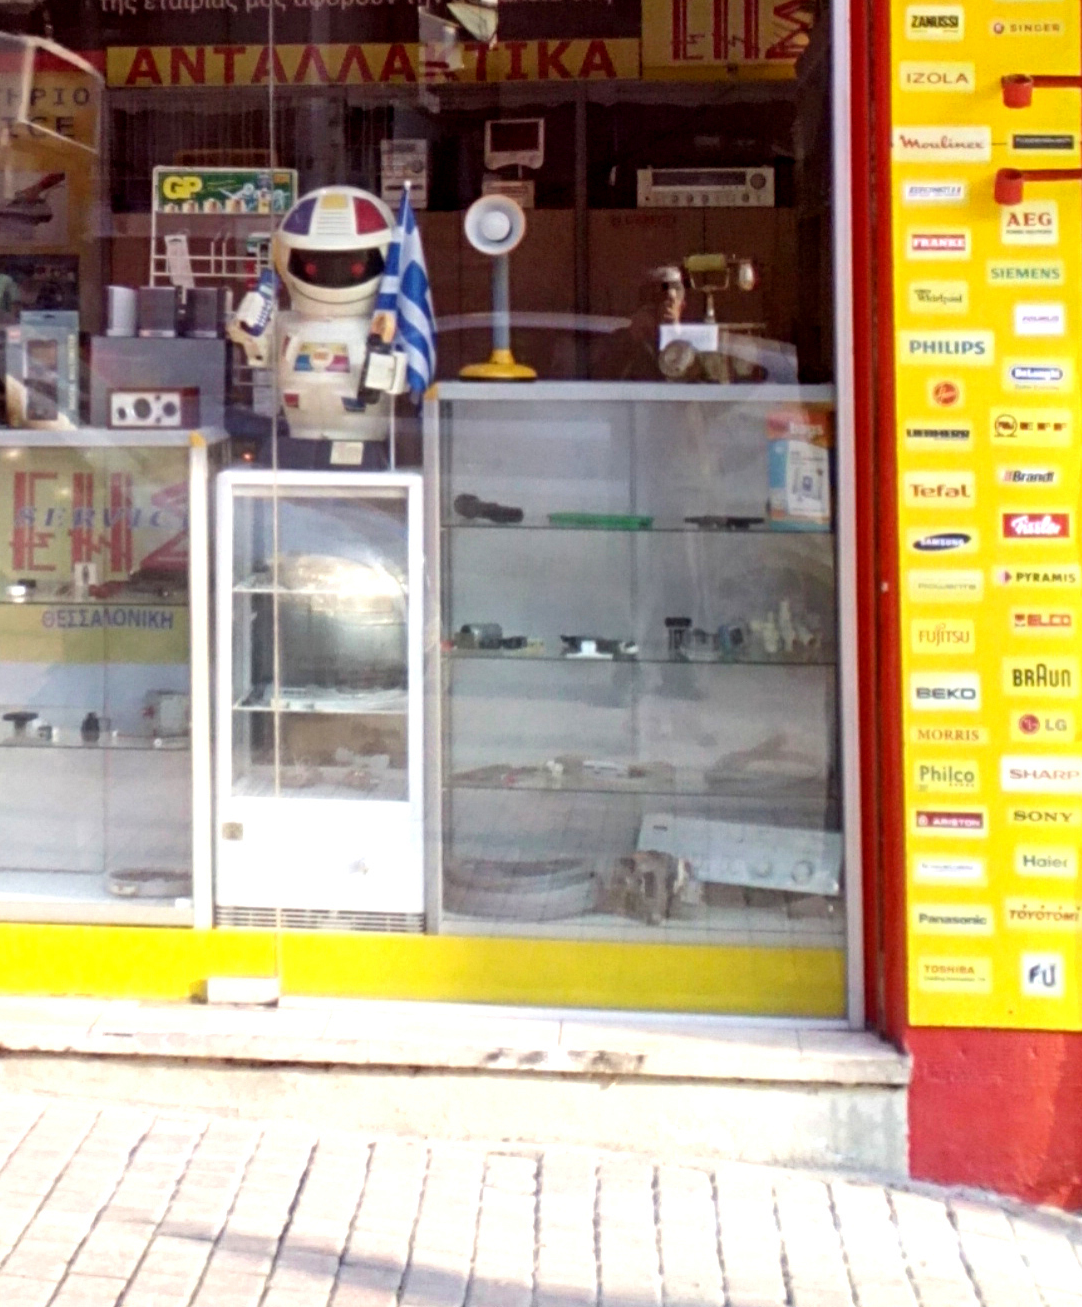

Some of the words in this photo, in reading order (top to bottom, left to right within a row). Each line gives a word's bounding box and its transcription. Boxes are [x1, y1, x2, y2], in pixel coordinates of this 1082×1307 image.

[911, 15, 959, 28] ZANUSSI
[1010, 23, 1059, 32] SINGER
[906, 72, 969, 84] IZOLA
[163, 176, 202, 199] GP
[1006, 212, 1052, 227] AEG
[990, 268, 1060, 280] SIEMENS
[909, 340, 986, 355] PHILIPS
[910, 484, 970, 498] Tefal
[1016, 572, 1075, 583] PYRAMIS
[42, 609, 173, 629] ΘΕΣΣΑΛΟΝΙΚΗ
[919, 623, 969, 646] FUJITSU
[1012, 663, 1071, 687] BRAUN
[916, 687, 976, 700] BEKO
[1045, 719, 1067, 731] LG
[918, 729, 979, 741] MORRIS
[919, 765, 975, 782] Philco
[1010, 769, 1079, 780] SHARP
[1013, 810, 1073, 822] SONY
[932, 818, 980, 827] ARISTON
[919, 913, 987, 925] Panasonic
[1009, 910, 1079, 923] TOYOTOMI
[924, 965, 975, 974] TOSHIBA
